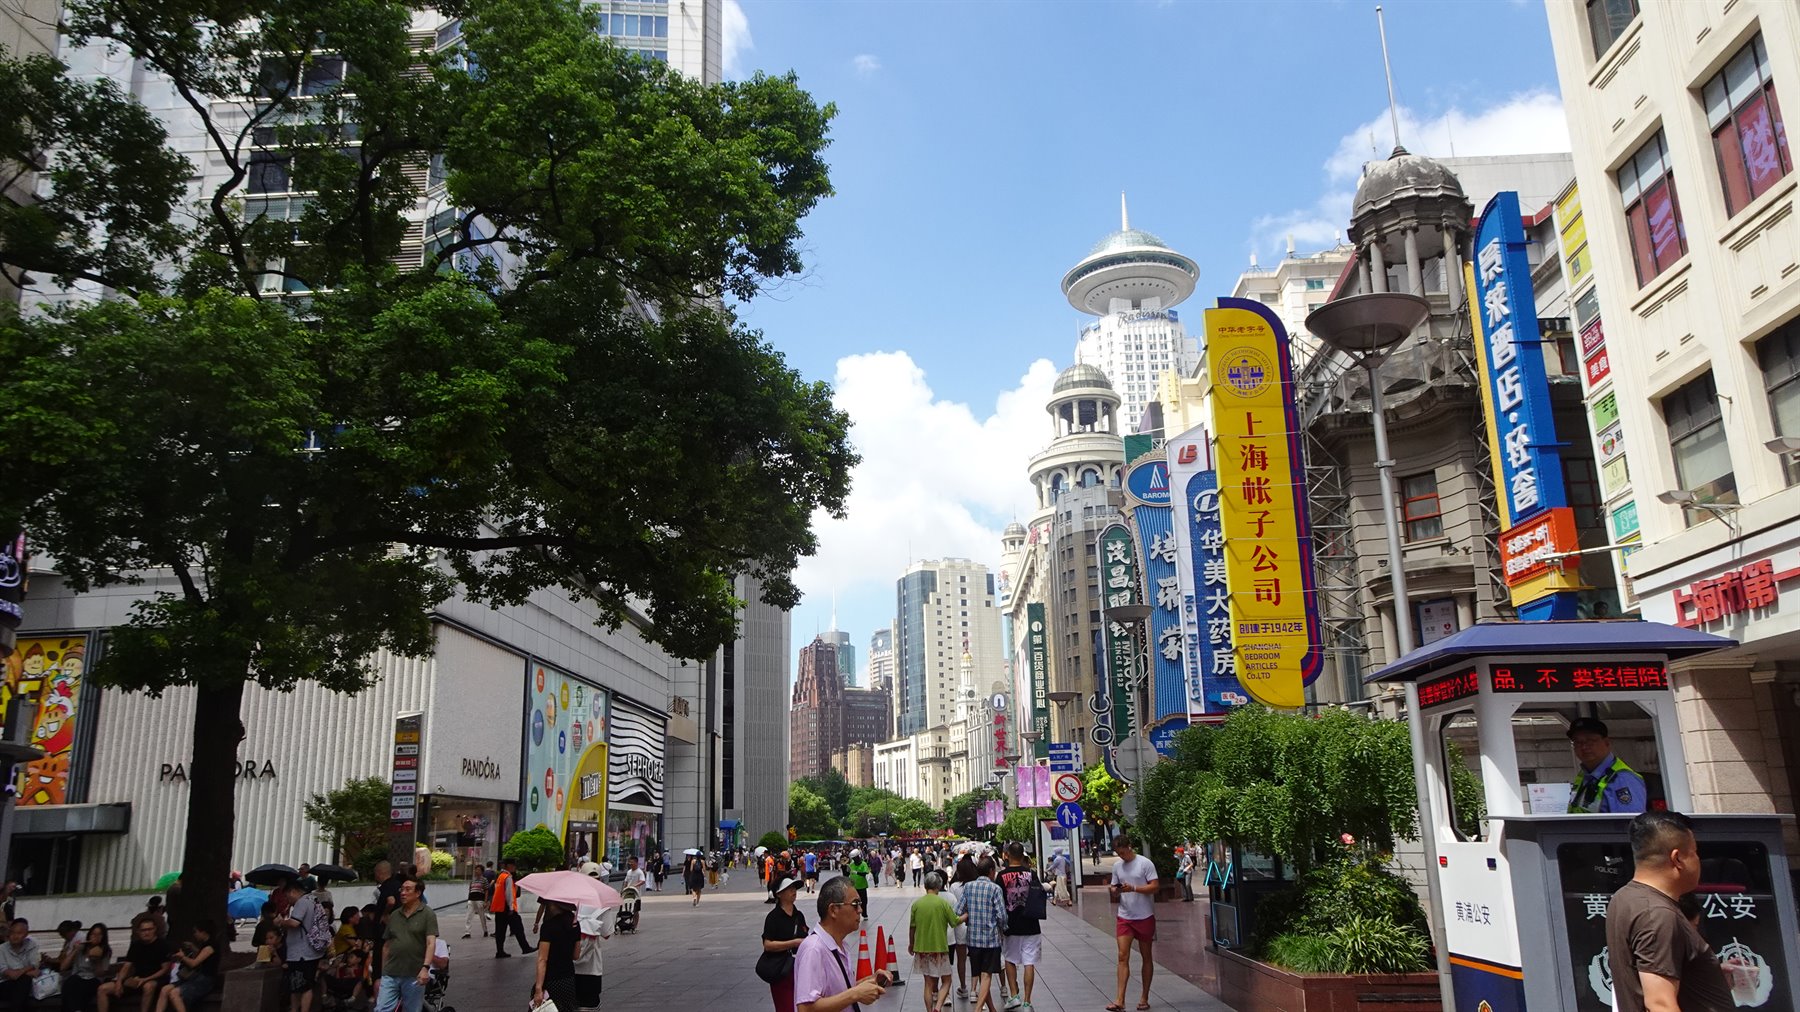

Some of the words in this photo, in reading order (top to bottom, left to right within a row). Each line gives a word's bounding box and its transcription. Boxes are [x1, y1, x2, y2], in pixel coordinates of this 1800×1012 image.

[1218, 325, 1265, 334] 中华老字号
[1238, 412, 1281, 606] 上海帐子公司
[1200, 529, 1235, 675] 华美大药房
[1239, 622, 1303, 634] 创建于1942年
[1114, 641, 1122, 667] SINCE
[1243, 643, 1281, 651] SHANGHAI
[1244, 652, 1281, 661] BEDROOM
[1032, 634, 1046, 709] 第一百货商业中心
[1188, 633, 1201, 704] Pharmacy
[1245, 662, 1279, 670] ARTICLES
[160, 759, 276, 781] PARA
[627, 753, 663, 781] SEPHORA
[1455, 901, 1491, 926] 黄浦公安
